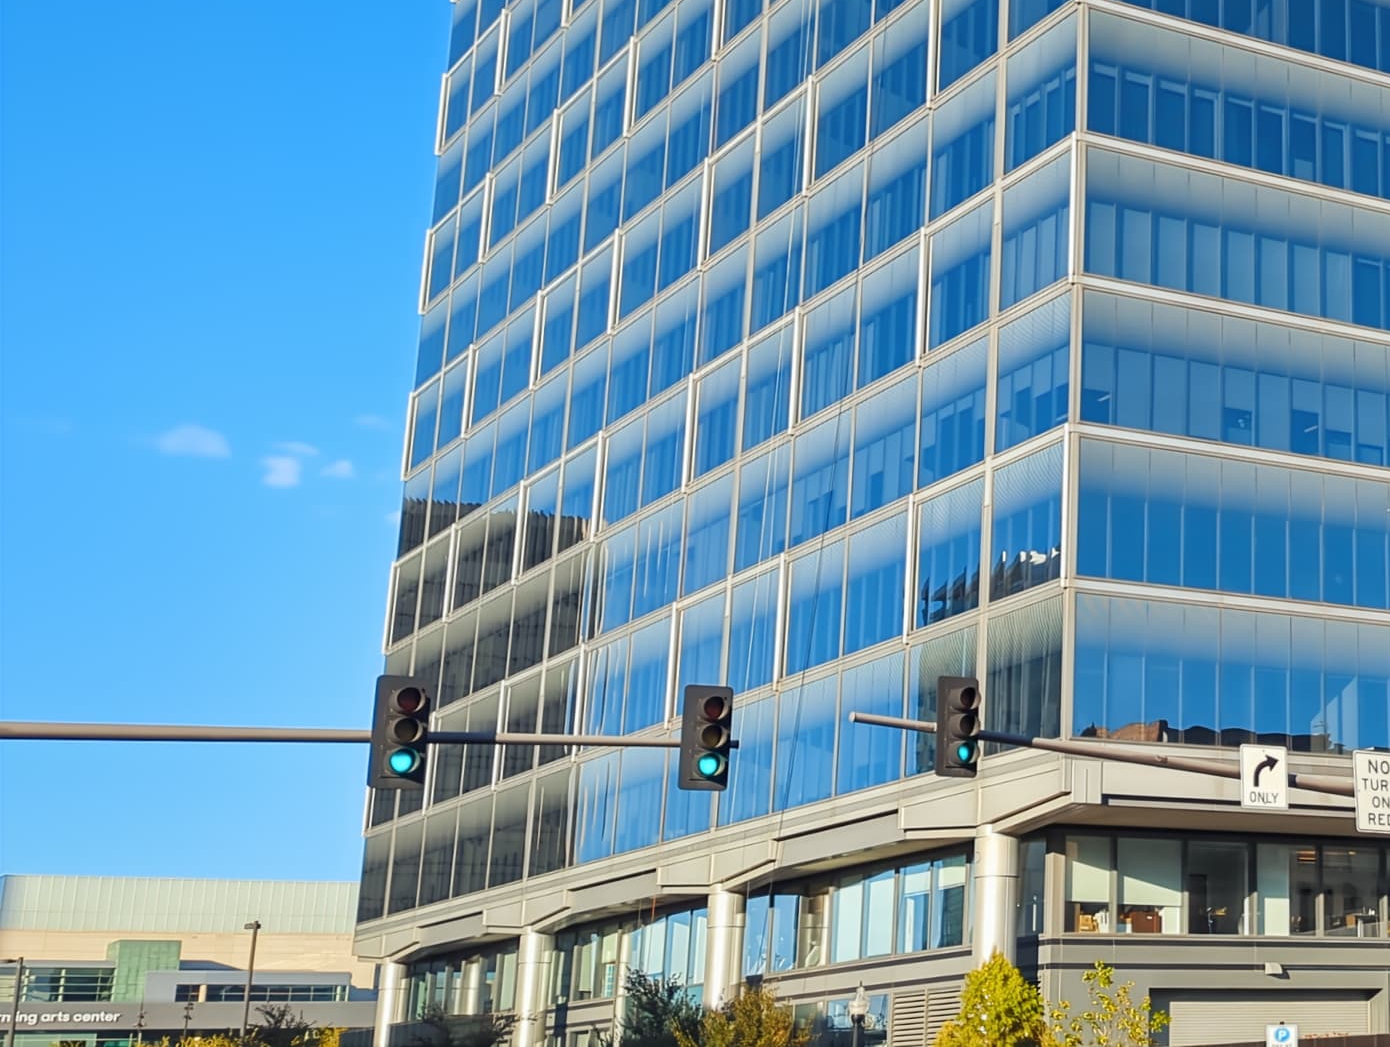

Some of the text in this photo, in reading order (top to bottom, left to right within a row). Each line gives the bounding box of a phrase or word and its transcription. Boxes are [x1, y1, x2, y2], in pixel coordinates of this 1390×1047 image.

[1367, 759, 1390, 774] NO
[1249, 791, 1279, 804] ONLY
[1372, 796, 1390, 809] ON
[40, 1011, 71, 1023] arts
[73, 1011, 121, 1023] center
